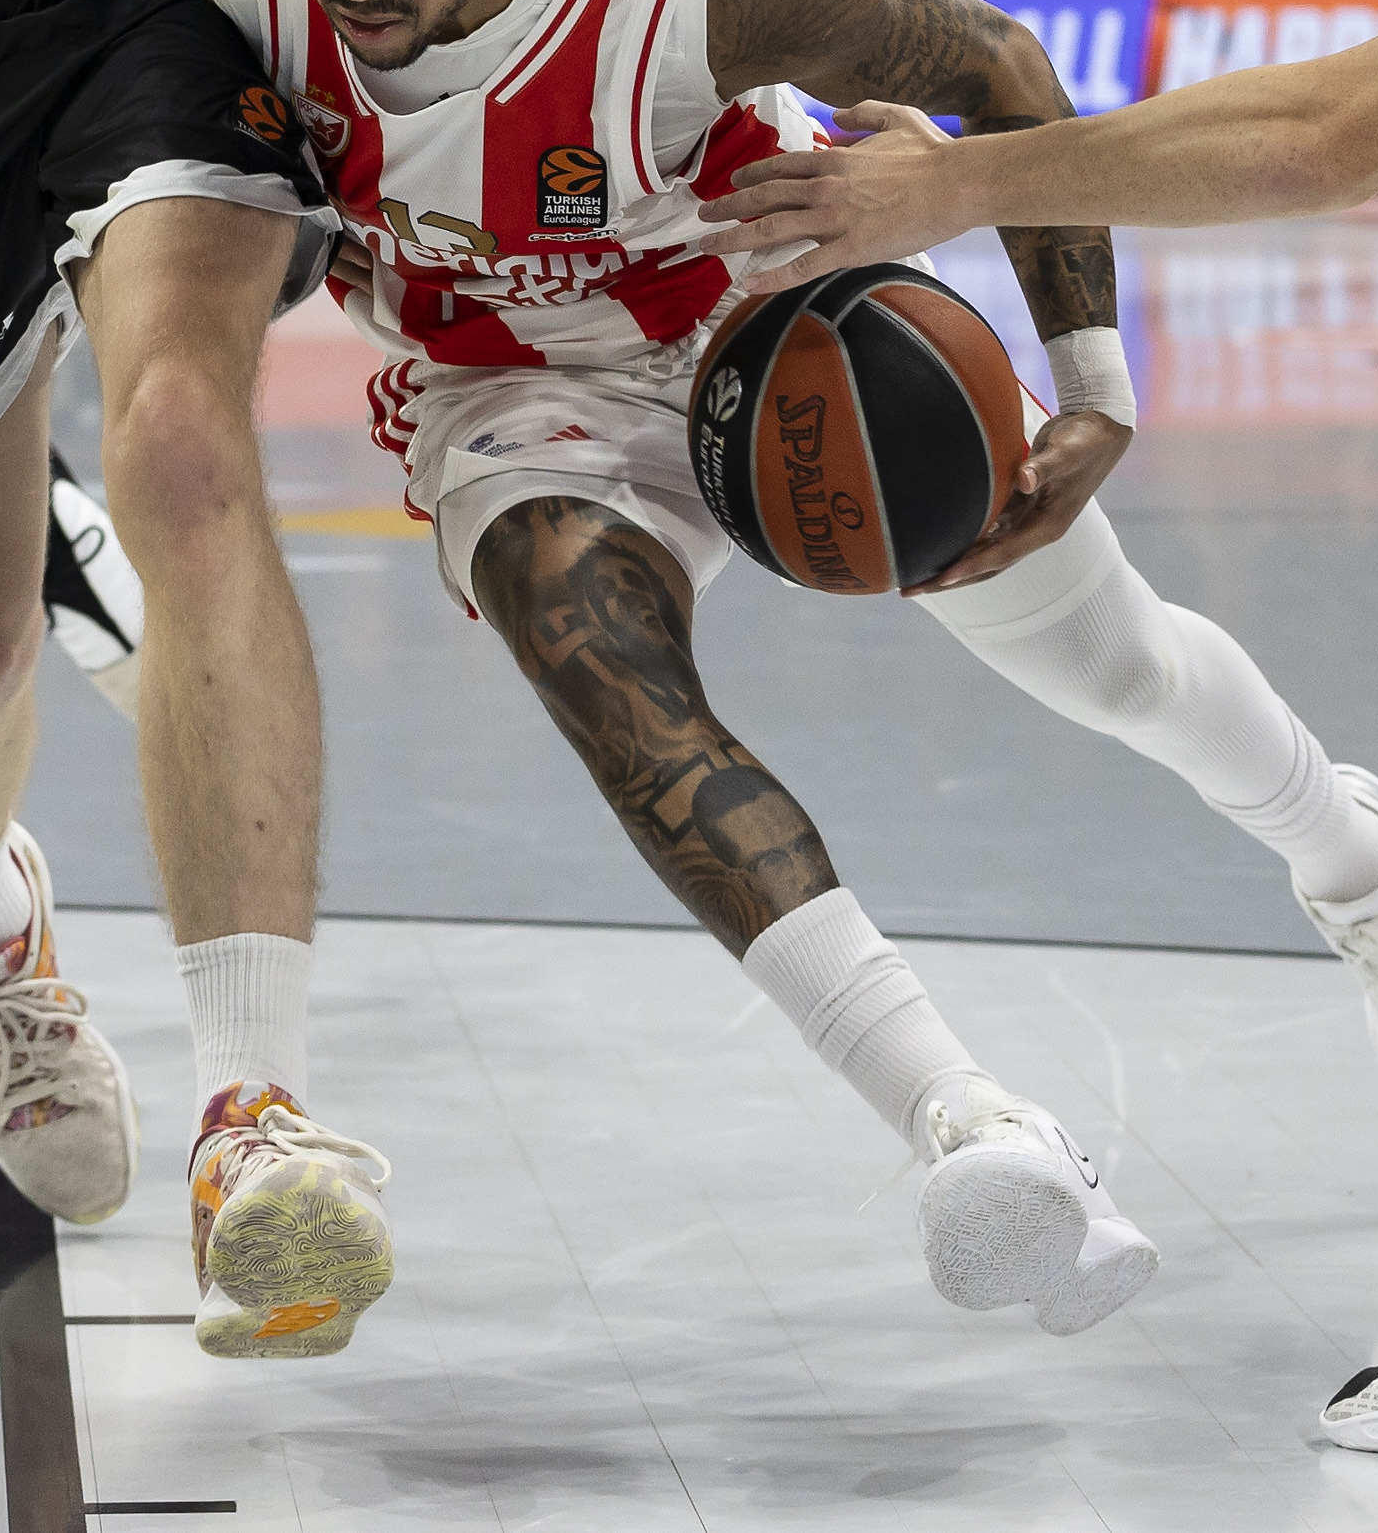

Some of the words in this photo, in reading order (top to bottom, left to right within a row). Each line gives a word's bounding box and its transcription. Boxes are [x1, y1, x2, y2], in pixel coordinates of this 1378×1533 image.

[545, 196, 601, 206] TURKISH
[544, 206, 601, 215] AIRLINES
[543, 215, 601, 226] EuroLeague
[775, 394, 870, 589] SPALDING
